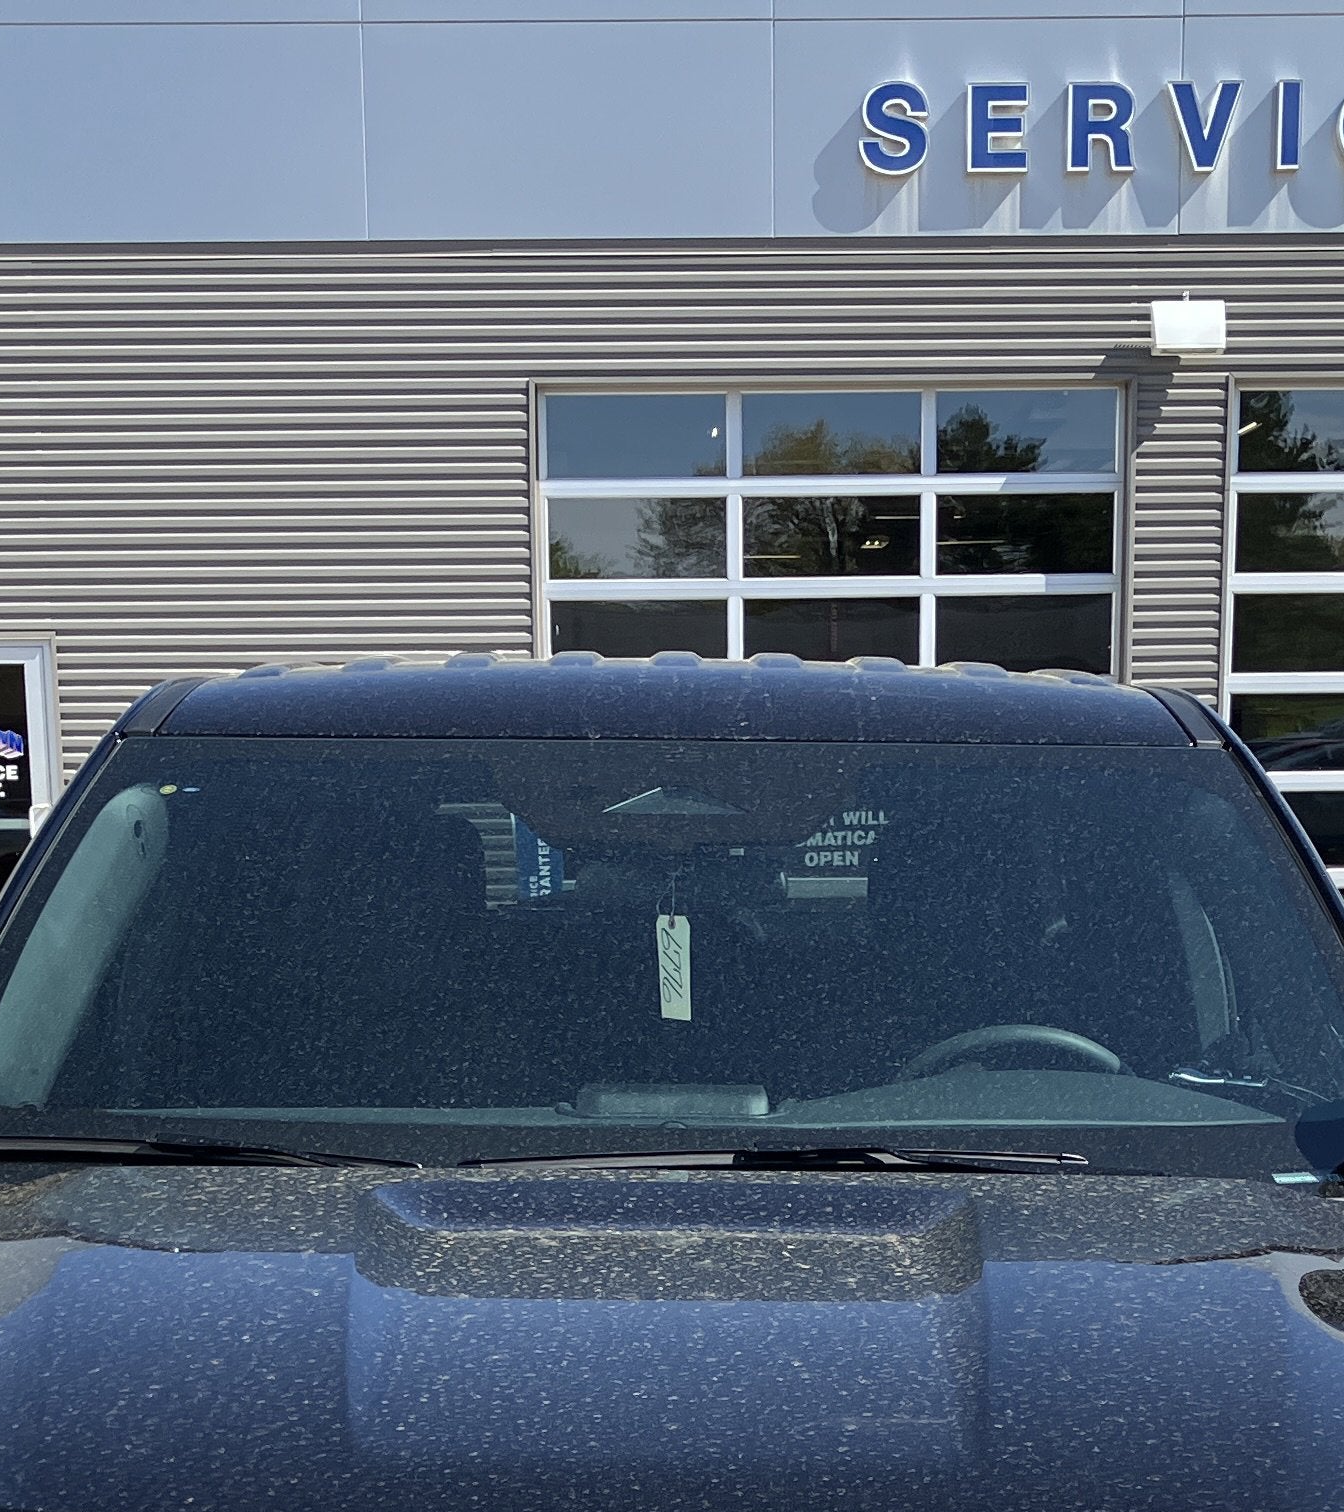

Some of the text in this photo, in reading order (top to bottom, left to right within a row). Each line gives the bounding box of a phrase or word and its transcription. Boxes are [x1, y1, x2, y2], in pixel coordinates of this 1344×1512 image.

[842, 810, 890, 826] WILL
[804, 850, 860, 867] OPEN
[661, 927, 683, 1003] 6776
